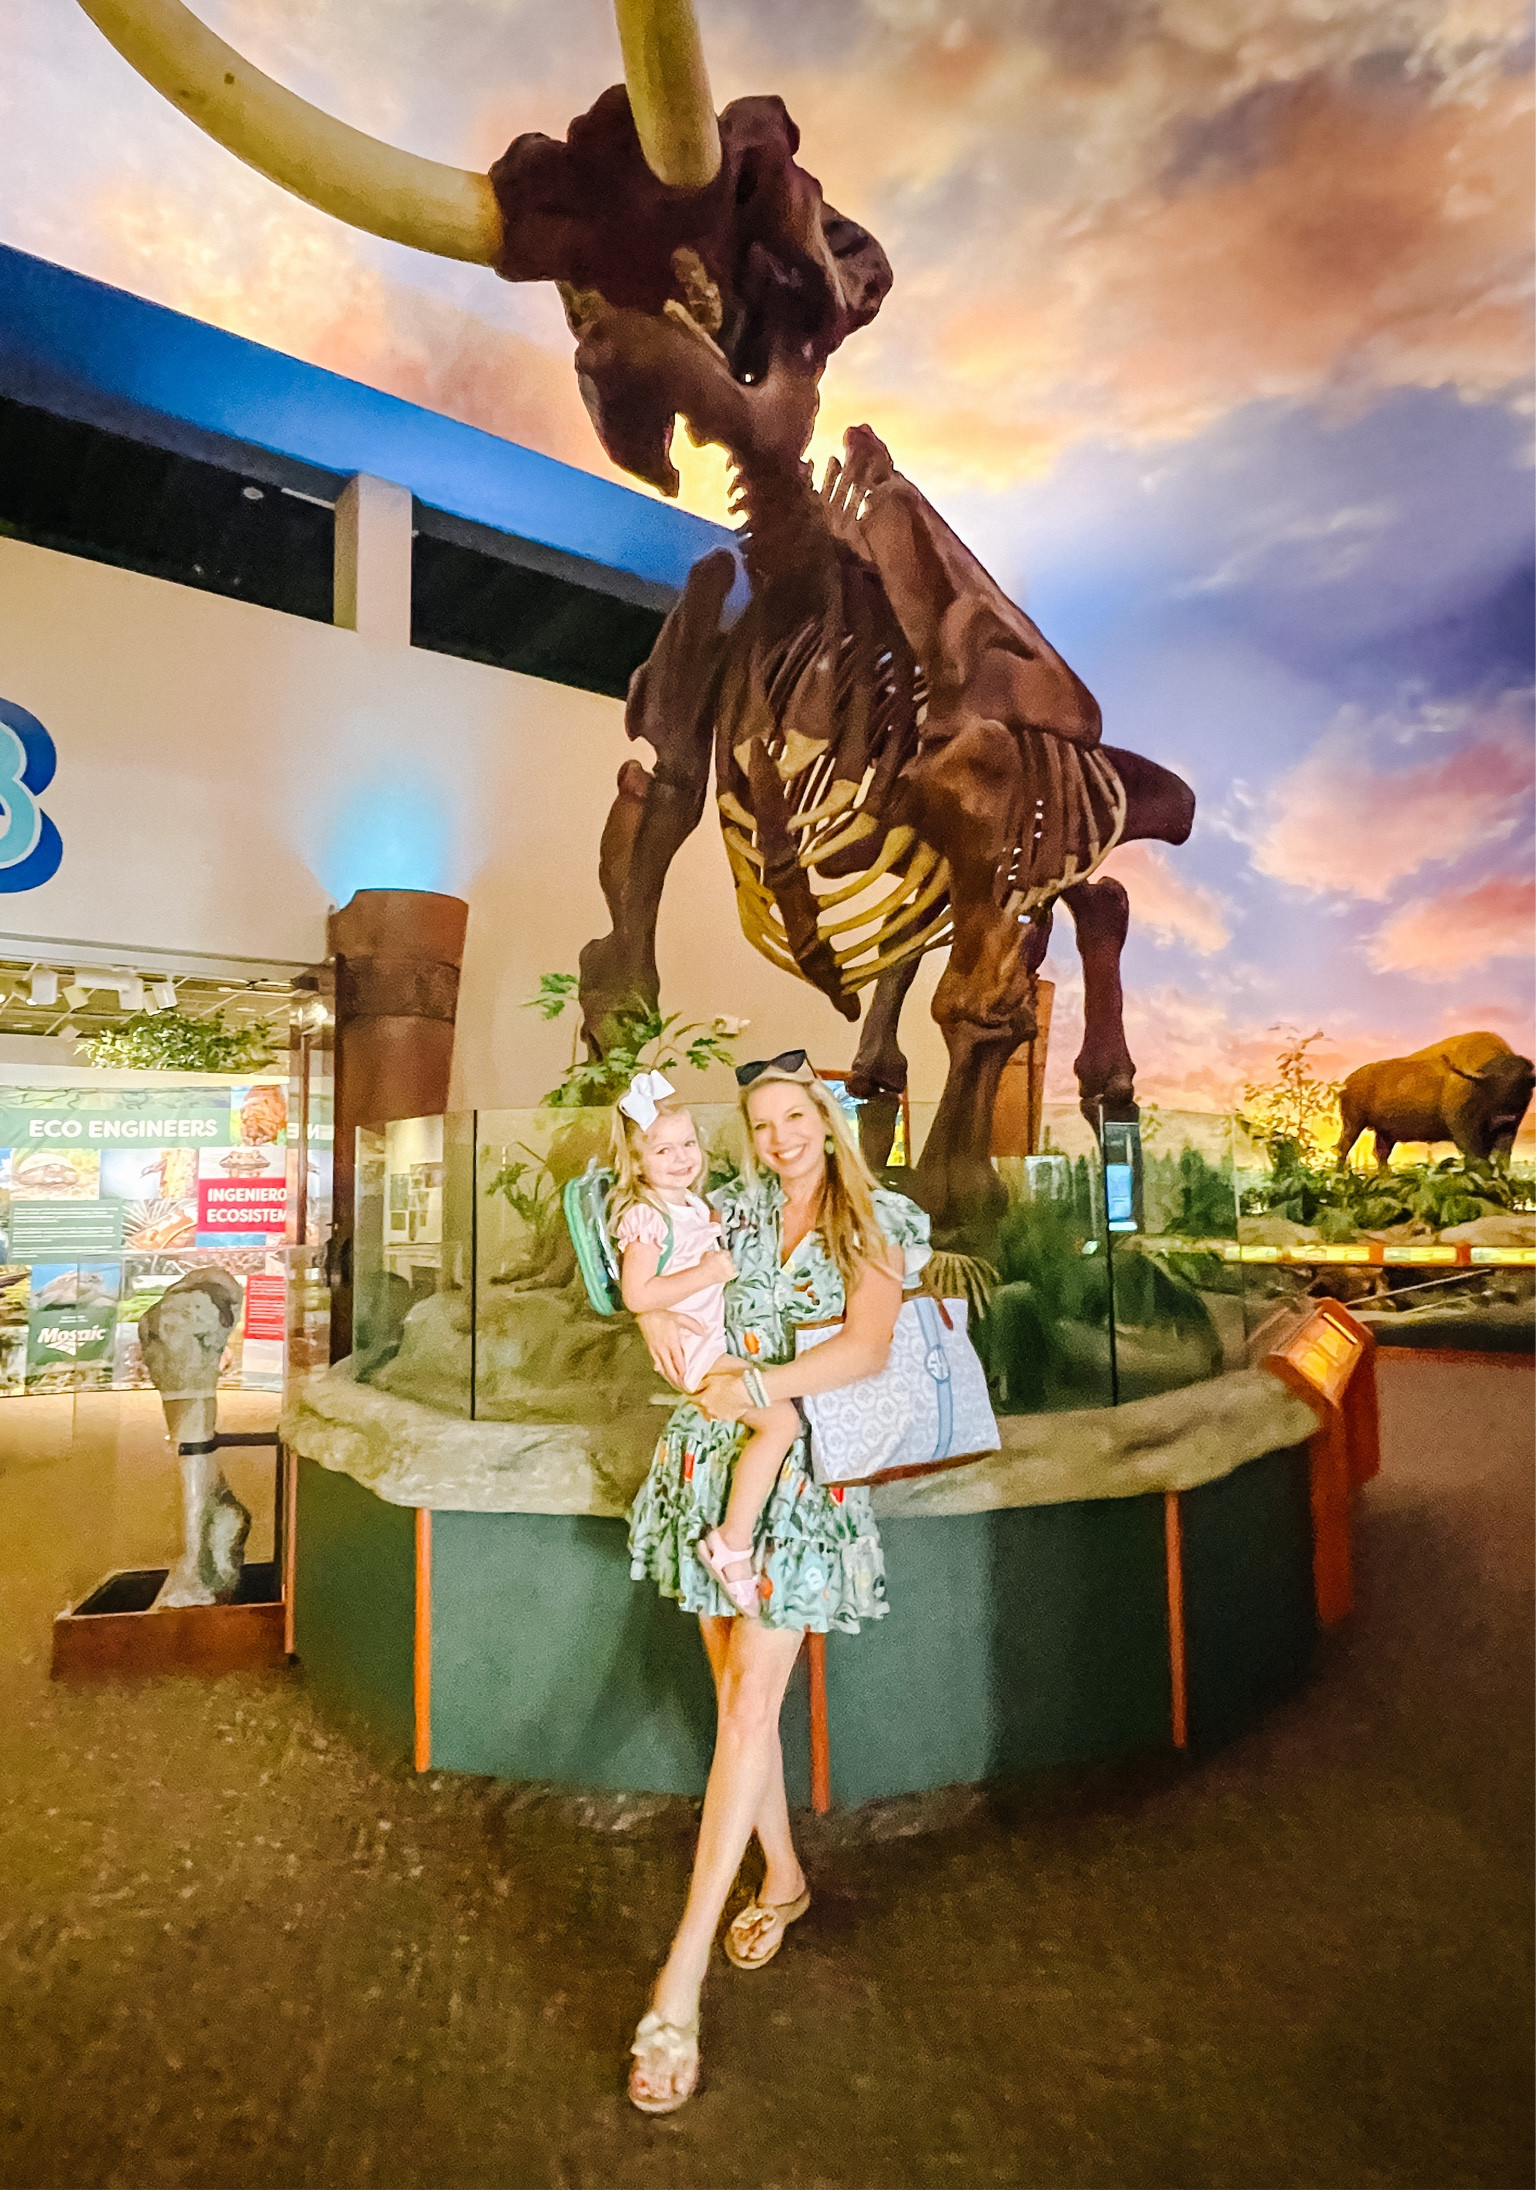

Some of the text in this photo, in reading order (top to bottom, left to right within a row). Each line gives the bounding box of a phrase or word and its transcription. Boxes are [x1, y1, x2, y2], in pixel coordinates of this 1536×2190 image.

[29, 1119, 218, 1138] ECO ENGINEERS
[207, 1187, 287, 1202] INGENIERO
[37, 1324, 106, 1343] Mosaic
